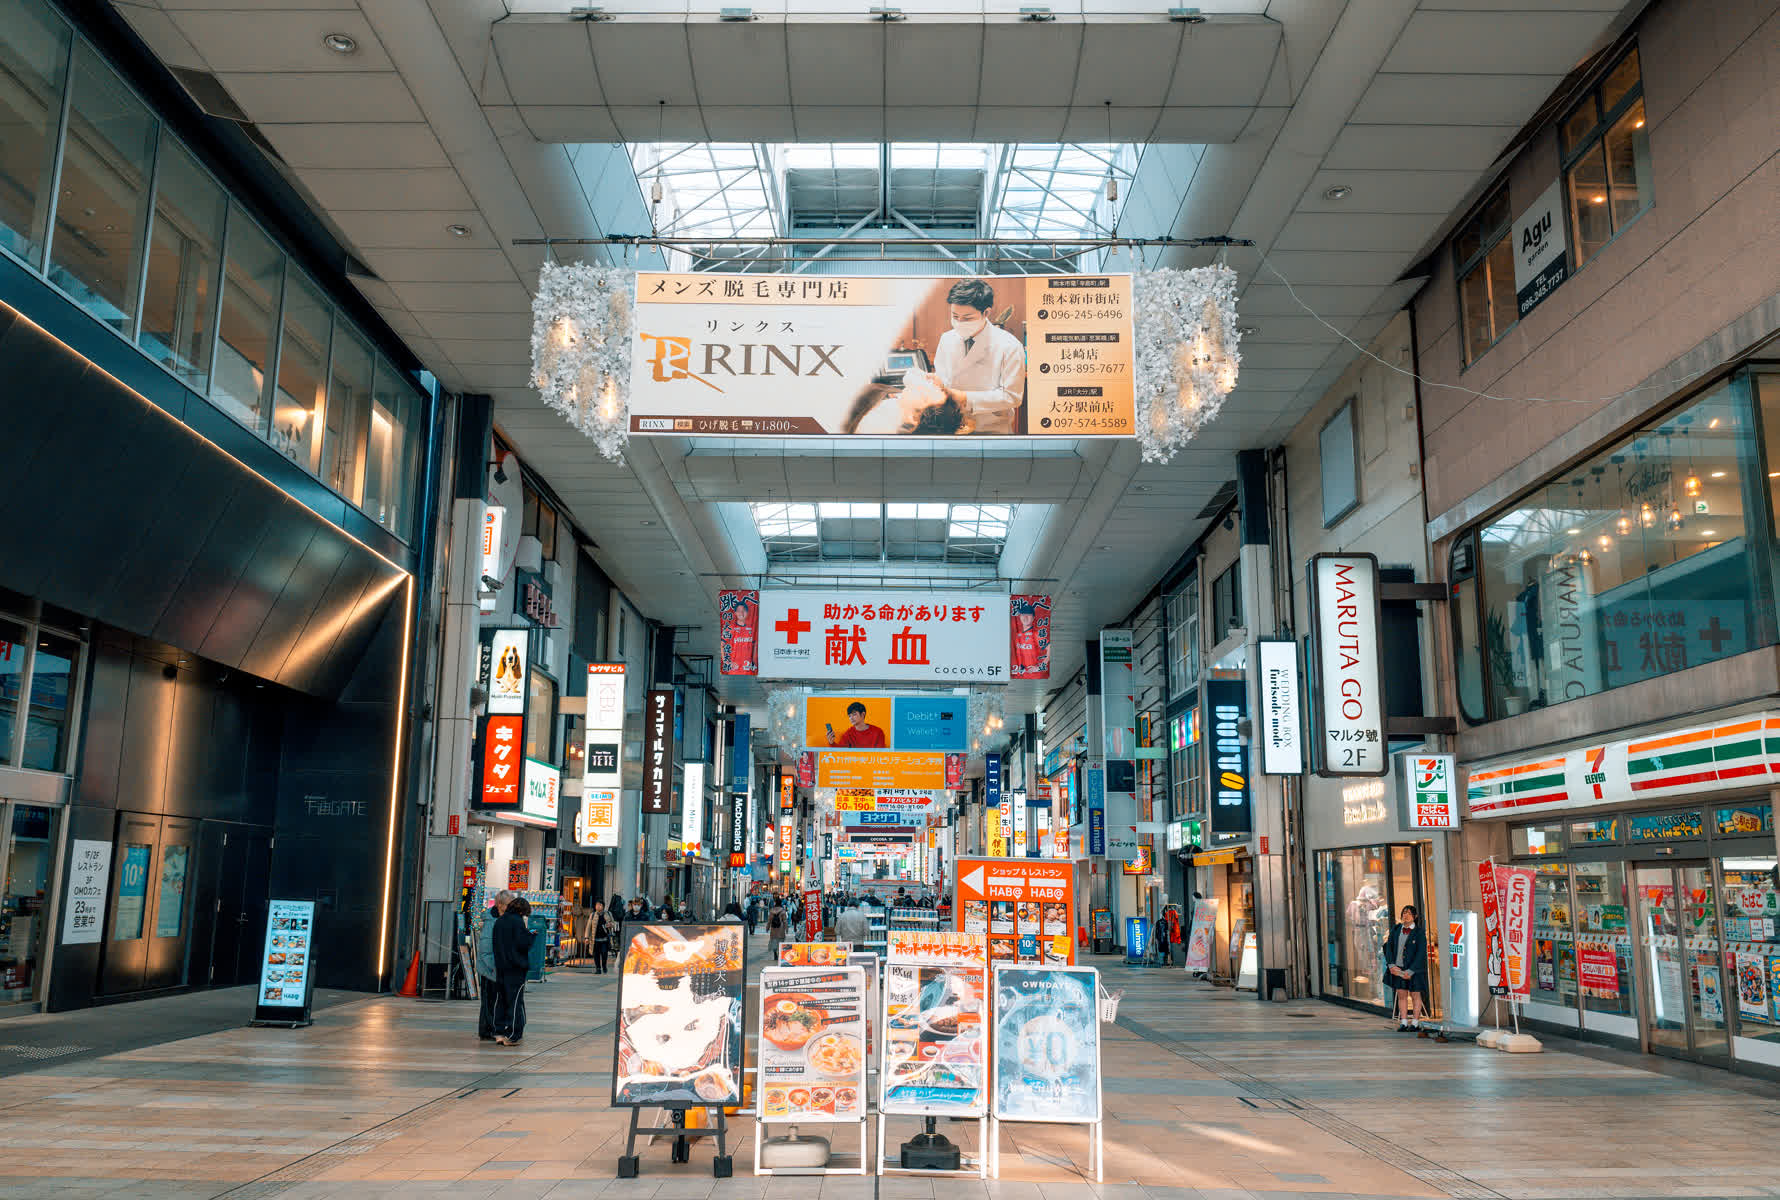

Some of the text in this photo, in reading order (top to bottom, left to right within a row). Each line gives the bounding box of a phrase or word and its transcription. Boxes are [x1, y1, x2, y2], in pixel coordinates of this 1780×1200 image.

[1522, 211, 1552, 254] Agu
[1528, 241, 1549, 267] garden
[1535, 273, 1546, 288] TEL
[650, 279, 849, 299] メンズ脱毛専門店
[1043, 293, 1120, 305] 熊本新市街店
[1051, 310, 1123, 319] 096-245-6496
[707, 319, 795, 333] リンクス
[700, 343, 845, 377] RINX
[1061, 348, 1099, 360] 長崎店
[1053, 364, 1125, 373] 095-895-7677
[1050, 401, 1114, 413] 大分駅前店
[642, 420, 665, 428] RINX
[699, 420, 739, 431] ひげ脱毛
[1054, 418, 1127, 428] 097-574-5589
[823, 604, 985, 622] 助かる命があります
[825, 624, 930, 666] 献血
[1334, 563, 1363, 720] MARUTA GO
[987, 666, 1002, 675] 5F
[1270, 669, 1283, 748] furisode mode
[1281, 669, 1292, 748] WEDDING BOX
[1328, 729, 1379, 743] マルタ號
[492, 725, 513, 779] キクタ
[653, 695, 667, 809] サンマルクカフェ
[1215, 705, 1246, 806] DOUTOR
[1343, 748, 1367, 766] 2F
[592, 755, 615, 767] TETE
[990, 760, 998, 795] LIFE
[485, 784, 516, 793] シューズ
[589, 803, 612, 826] 薬
[1421, 805, 1446, 814] たばこ
[733, 797, 744, 852] McDonald's
[1421, 816, 1449, 826] ATM
[78, 862, 104, 872] レストラン
[1741, 893, 1764, 909] たばこ
[73, 915, 96, 928] 営業中
[895, 942, 984, 957] ホットサンドランチ
